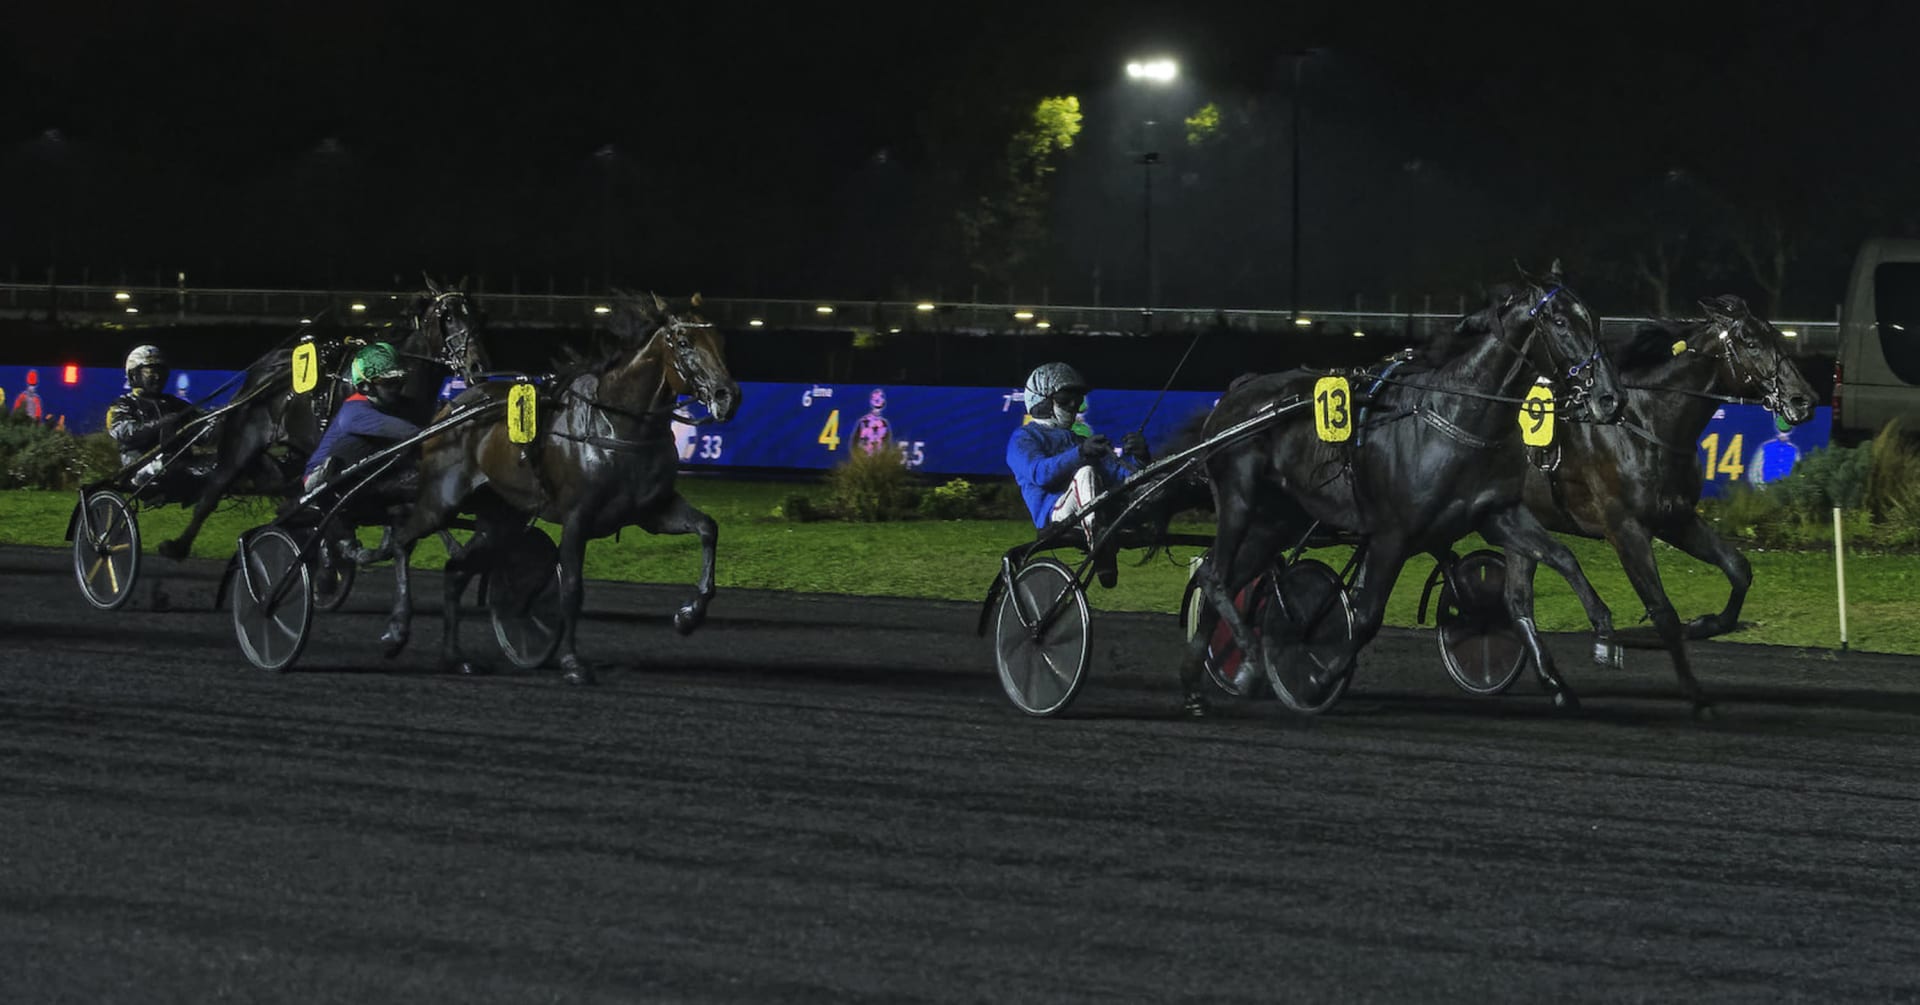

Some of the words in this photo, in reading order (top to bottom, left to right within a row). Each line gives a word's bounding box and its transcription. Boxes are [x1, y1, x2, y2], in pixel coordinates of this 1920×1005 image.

[299, 352, 310, 383] 7
[516, 395, 525, 432] 1
[1317, 388, 1348, 429] 13
[1527, 397, 1545, 434] 9
[699, 435, 723, 460] 33
[818, 409, 841, 451] 4
[1700, 432, 1745, 481] 14
